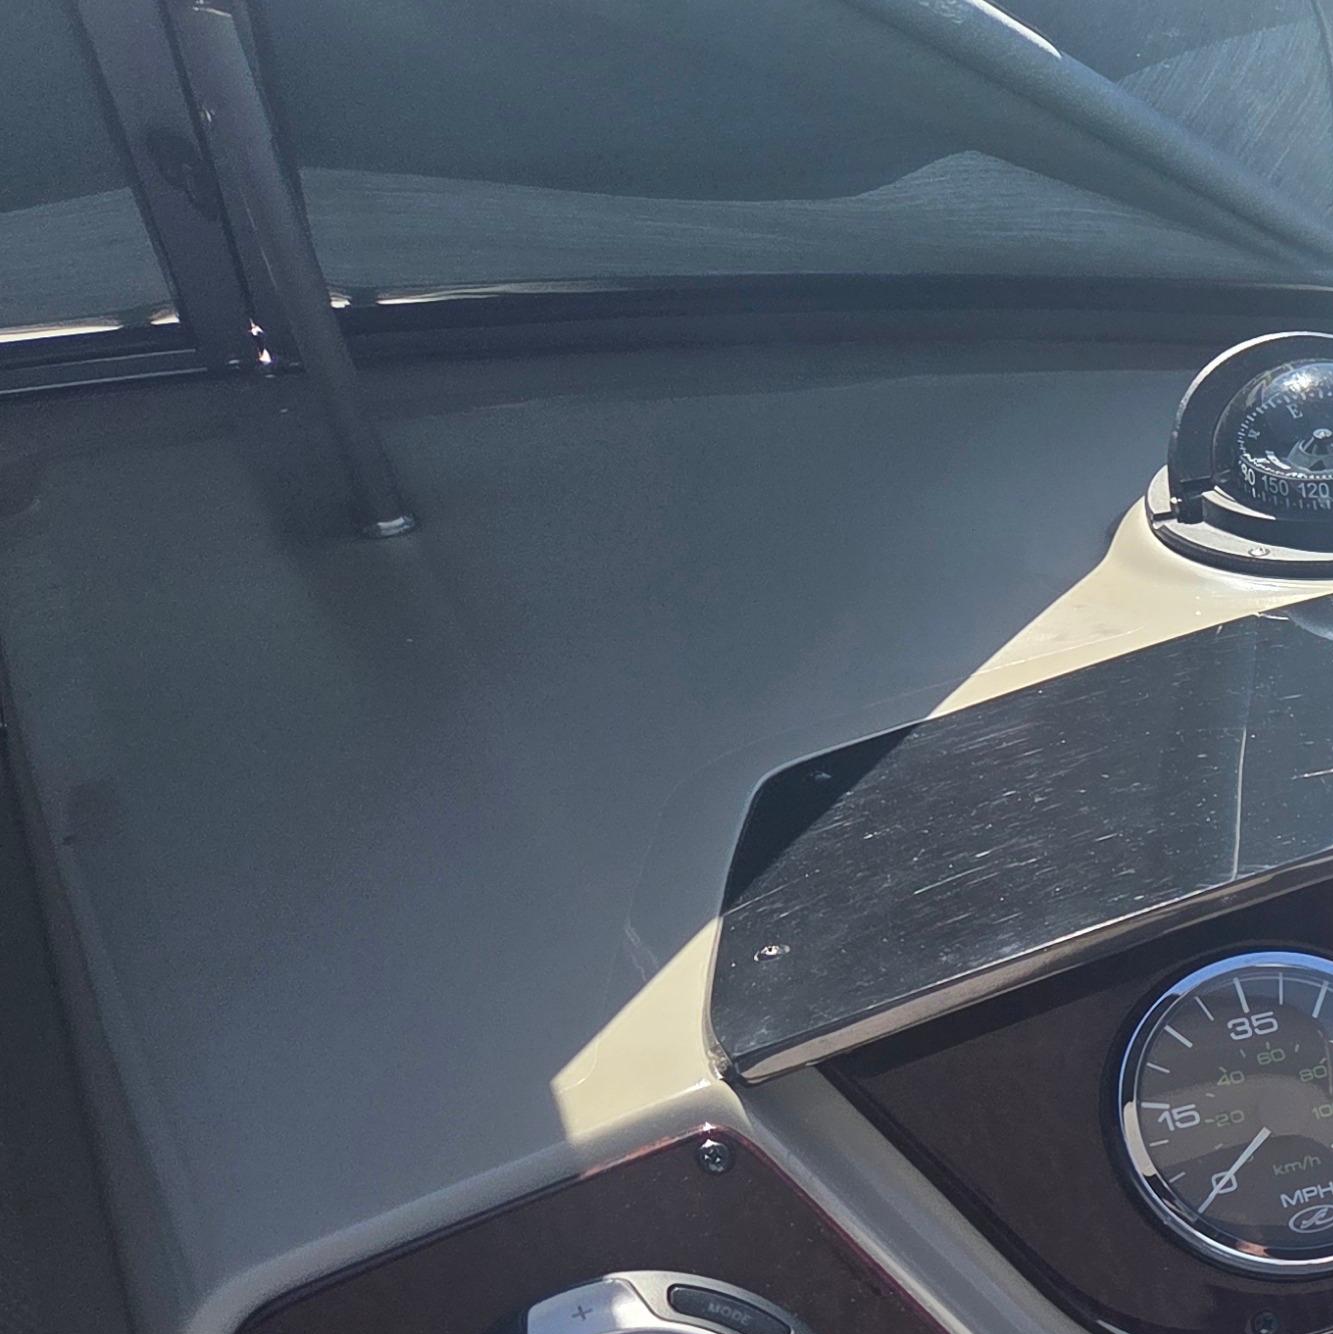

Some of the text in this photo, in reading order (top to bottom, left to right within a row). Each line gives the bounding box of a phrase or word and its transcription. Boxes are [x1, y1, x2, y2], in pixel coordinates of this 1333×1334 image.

[1262, 475, 1289, 496] 150
[1298, 482, 1330, 498] 120
[1227, 1011, 1279, 1041] 35
[1256, 1049, 1286, 1065] 60
[1217, 1071, 1245, 1087] 40
[1299, 1064, 1328, 1082] 80
[1157, 1103, 1201, 1132] 15
[1272, 1154, 1321, 1177] km/h
[706, 1302, 753, 1326] MODE
